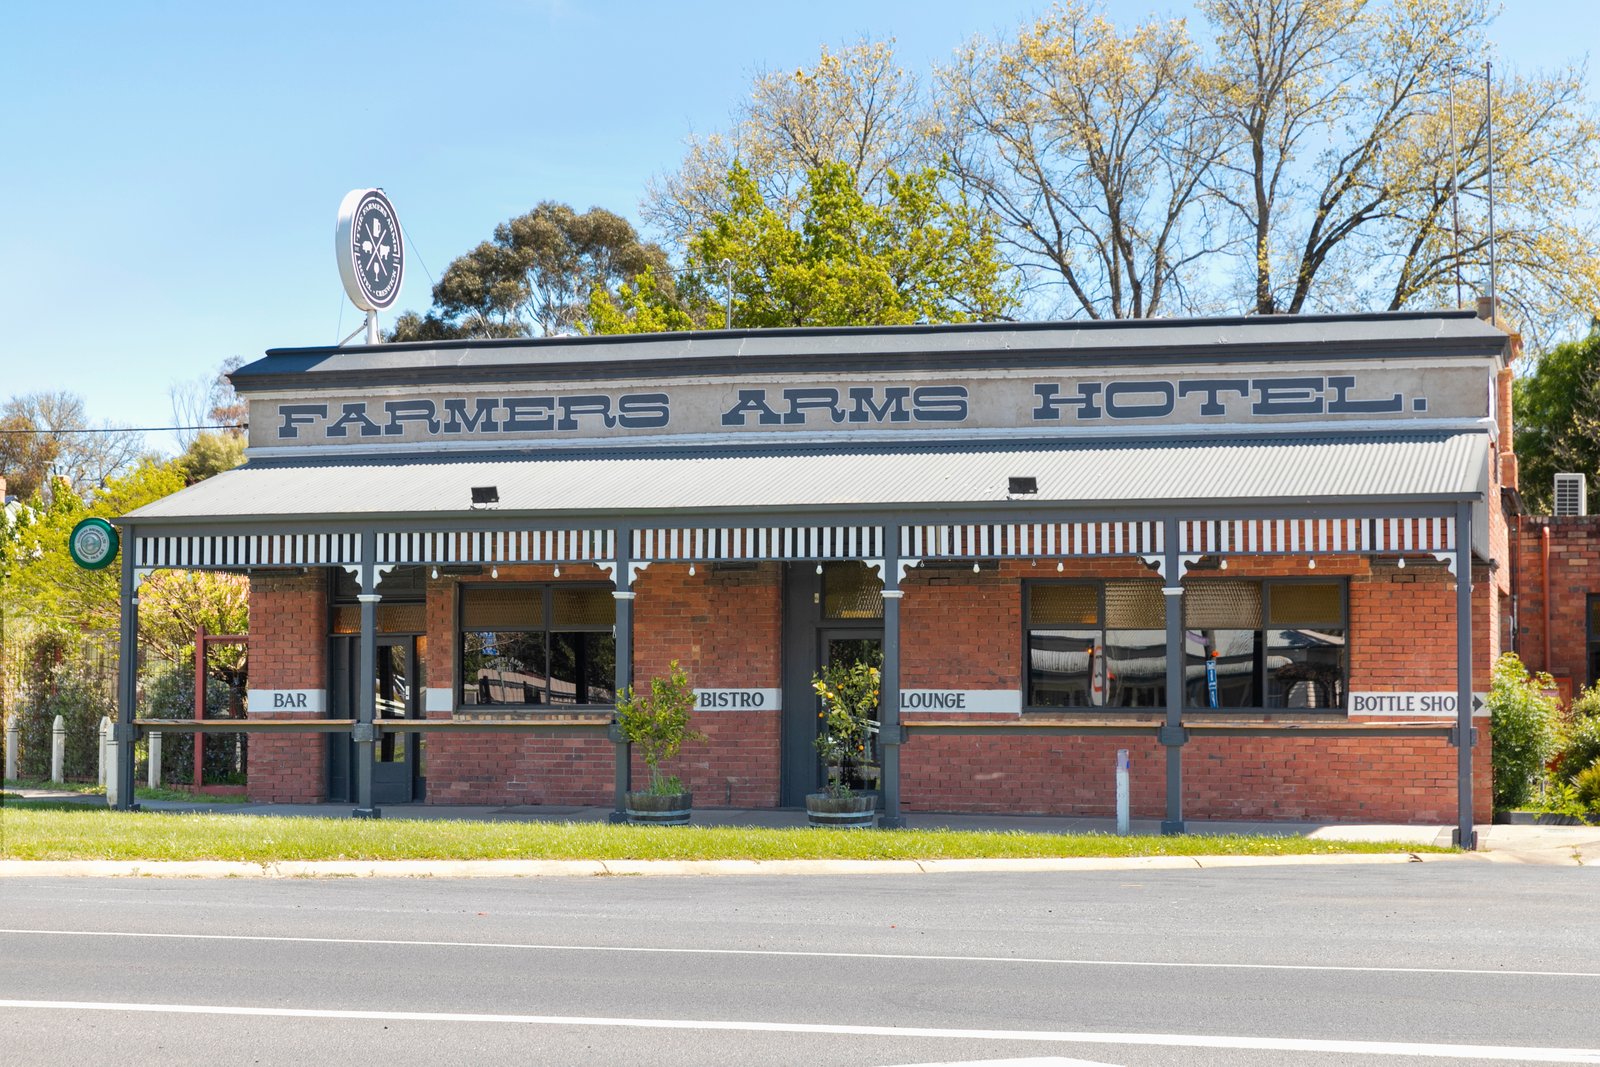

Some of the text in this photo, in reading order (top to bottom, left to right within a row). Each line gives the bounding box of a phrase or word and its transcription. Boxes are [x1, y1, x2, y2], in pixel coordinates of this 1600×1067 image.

[362, 202, 387, 218] FARMERS
[386, 218, 397, 252] ARMS
[278, 376, 1427, 439] FARMERS ARMS HOTEL.
[273, 693, 307, 708] BAR
[700, 692, 765, 707] BISTRO
[901, 692, 966, 709] LOUNGE
[1353, 695, 1458, 712] BOTTLE SHO
